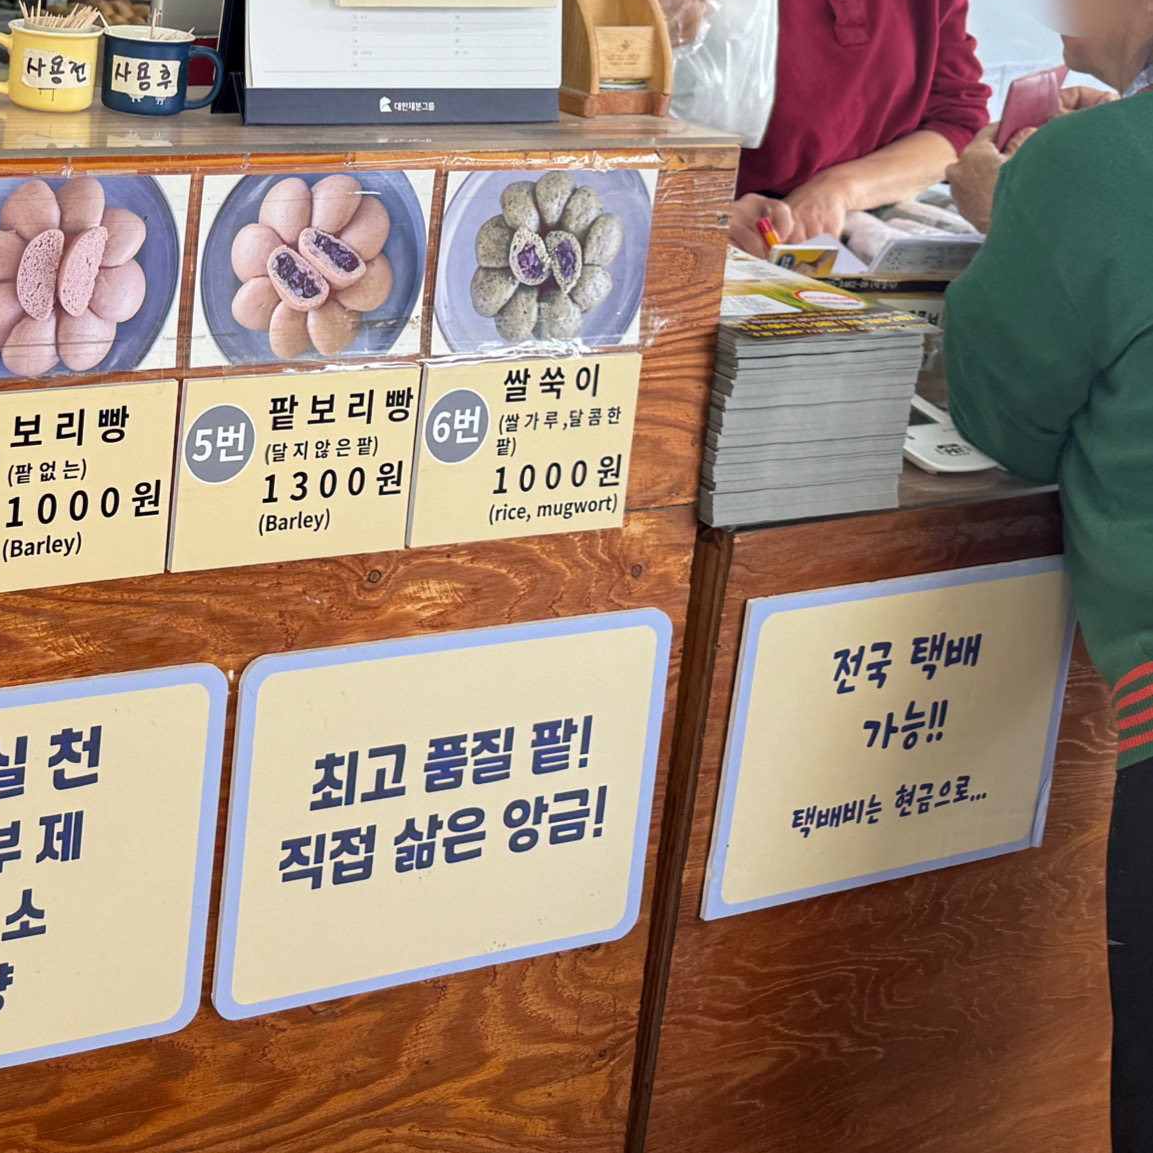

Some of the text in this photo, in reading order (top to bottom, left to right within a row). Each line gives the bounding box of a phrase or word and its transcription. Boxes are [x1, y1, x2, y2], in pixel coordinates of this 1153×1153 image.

[27, 55, 86, 84] 사용전
[192, 423, 245, 462] 5번
[433, 406, 480, 443] 6번
[496, 437, 516, 457] 팥)
[259, 509, 330, 536] (Barley)
[490, 494, 617, 525] (rice, mugwort)
[3, 532, 81, 562] (Barley)
[834, 632, 982, 694] 전국 택배
[864, 700, 948, 750] 가능!!
[310, 715, 592, 811] 최고 품질 팥!
[792, 776, 986, 838] 택배비는 현금으로...
[279, 785, 607, 890] 직접 삶은 앙금!
